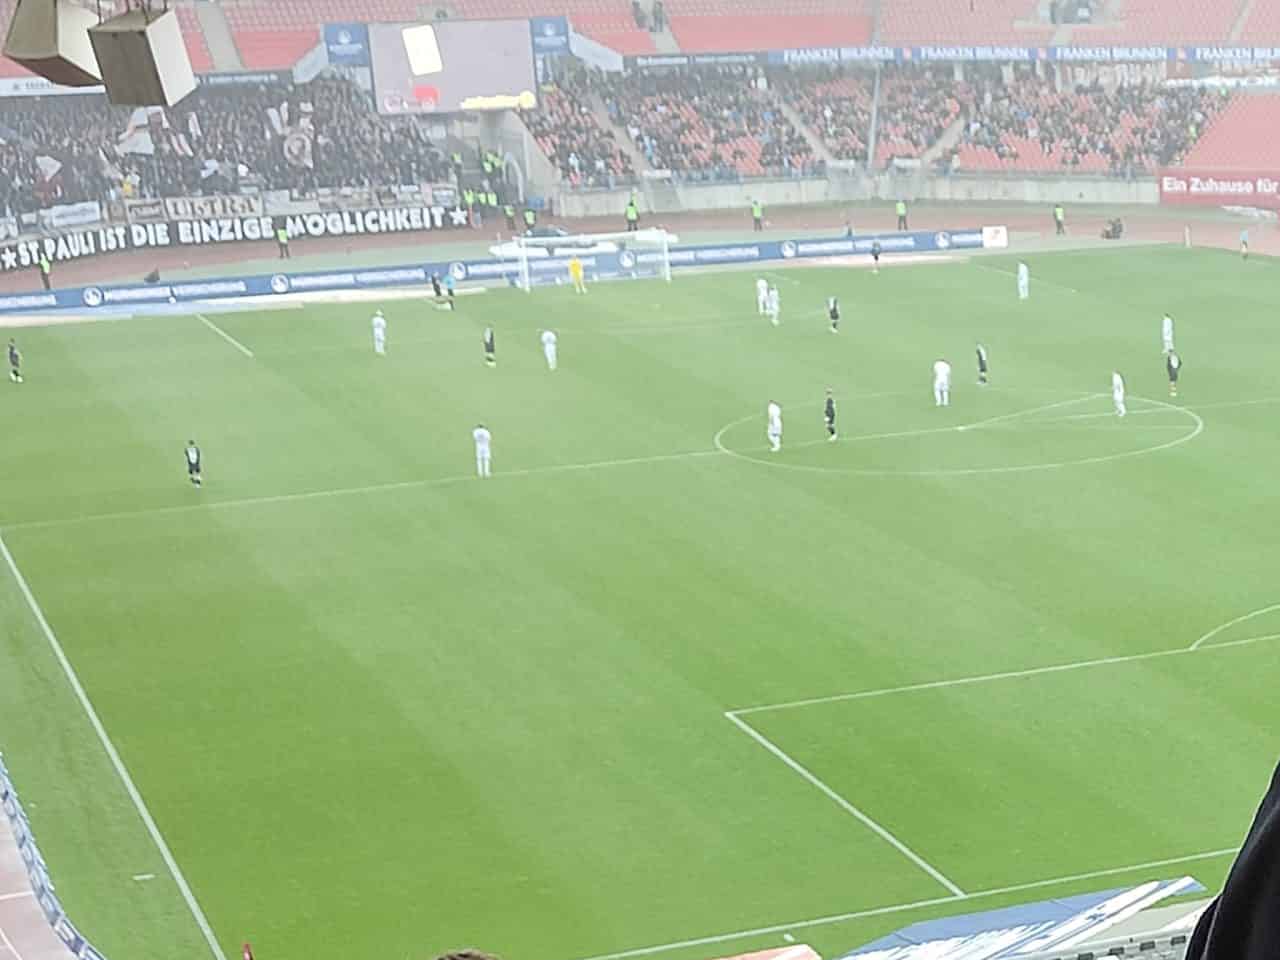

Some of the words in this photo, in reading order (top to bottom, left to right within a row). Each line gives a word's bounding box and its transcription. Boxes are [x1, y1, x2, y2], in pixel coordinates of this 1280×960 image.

[1162, 177, 1187, 193] Ein
[1190, 177, 1254, 193] Zuhause
[1256, 177, 1279, 193] für
[44, 231, 96, 261] PAULI
[100, 226, 127, 252] IST
[131, 223, 170, 246] DIE
[178, 216, 274, 244] EINZIGE
